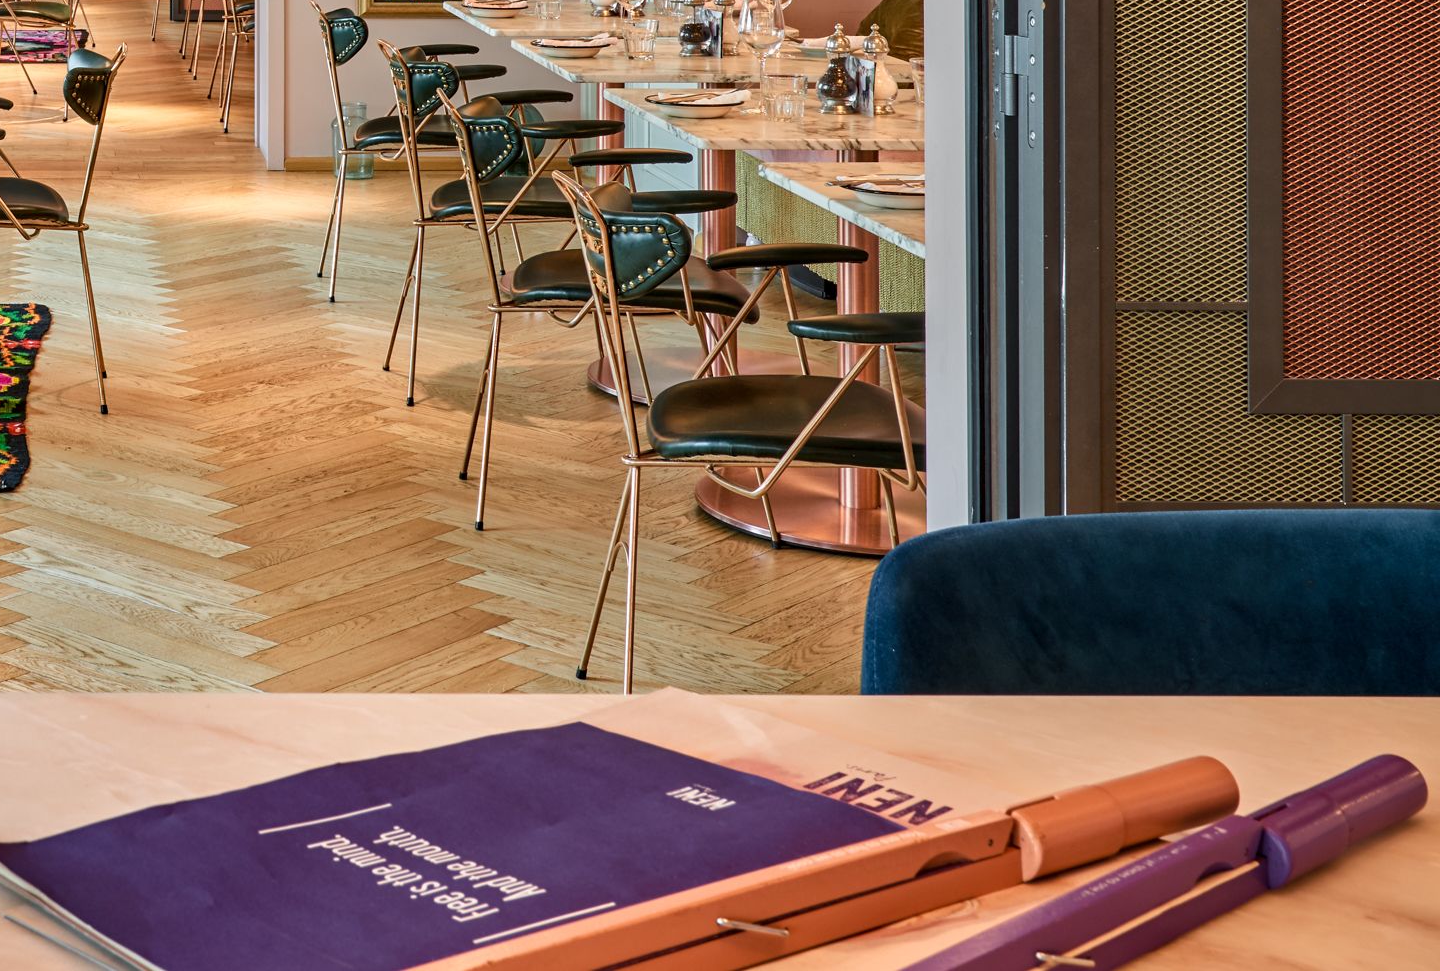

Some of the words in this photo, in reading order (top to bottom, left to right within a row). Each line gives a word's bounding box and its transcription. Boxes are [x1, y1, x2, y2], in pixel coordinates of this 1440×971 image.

[665, 786, 737, 811] NENI
[803, 771, 954, 825] NENI
[307, 834, 387, 868] mind.
[373, 826, 461, 865] mouth.
[371, 864, 422, 887] the
[447, 860, 498, 881] the
[410, 881, 448, 900] is
[472, 876, 547, 902] And
[433, 891, 500, 922] Free
